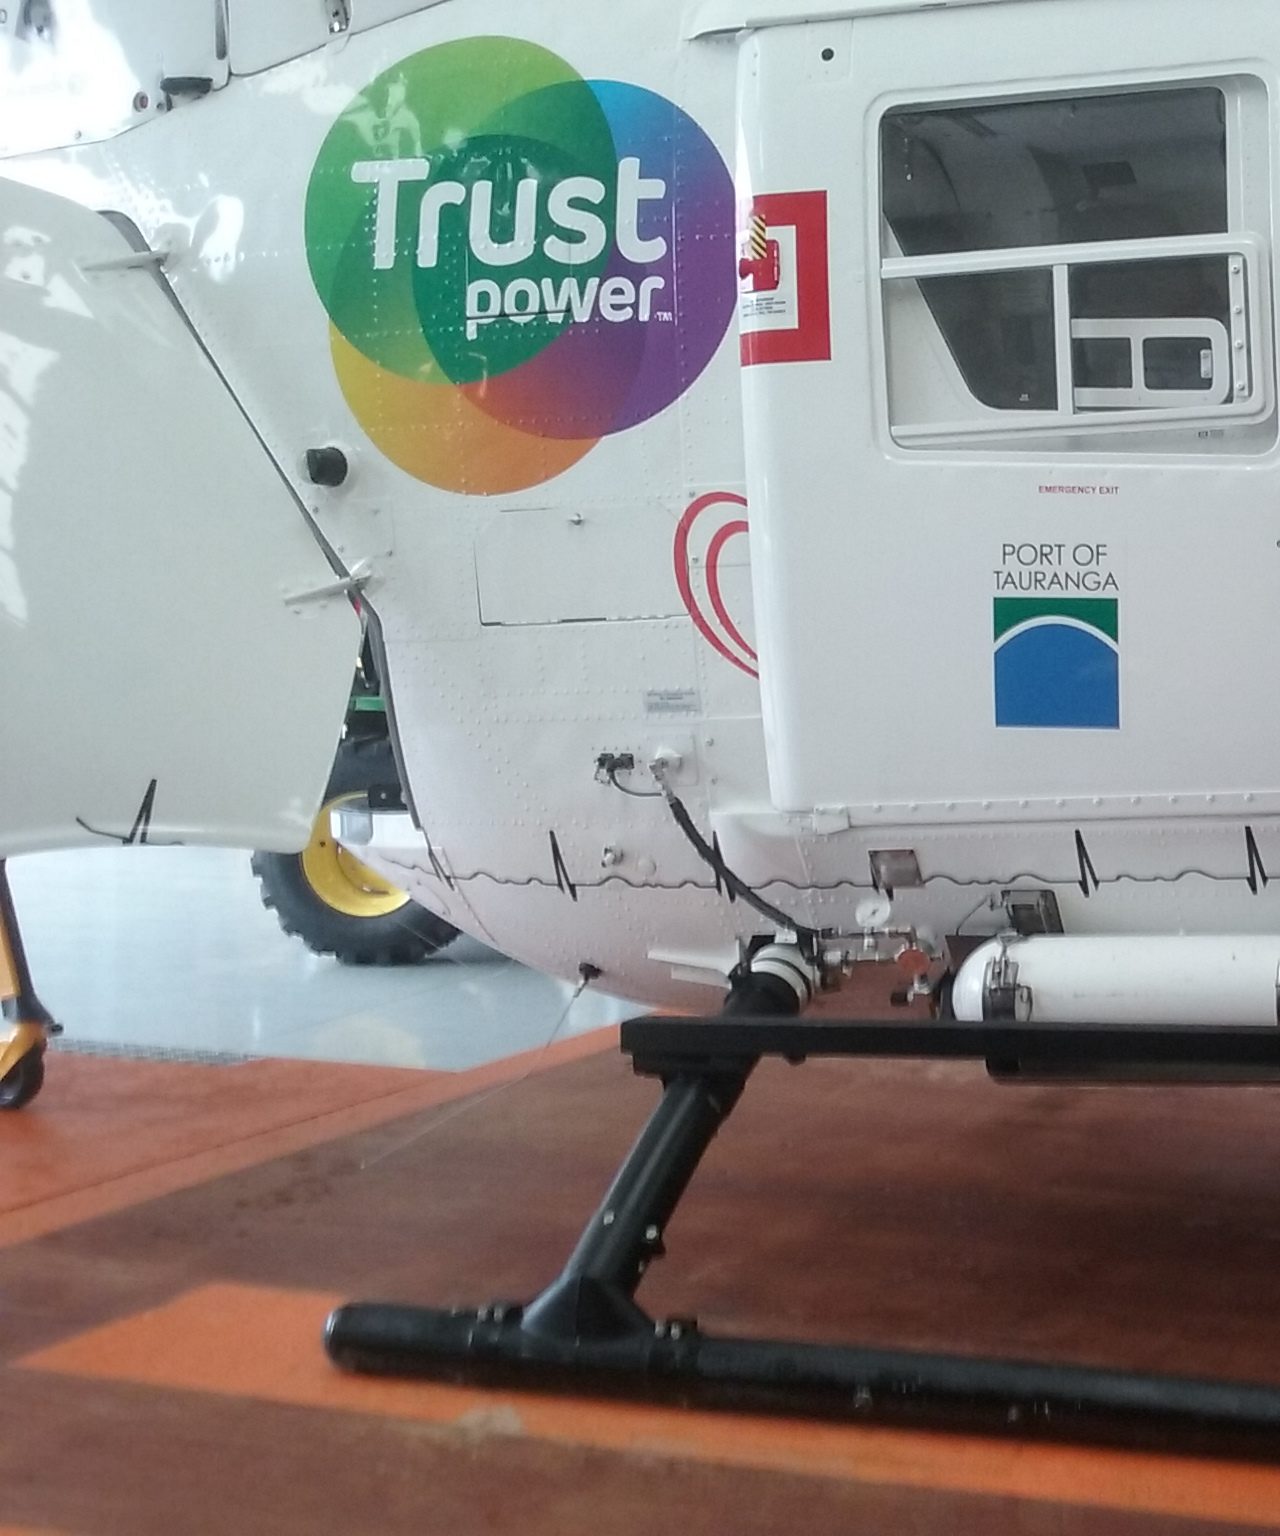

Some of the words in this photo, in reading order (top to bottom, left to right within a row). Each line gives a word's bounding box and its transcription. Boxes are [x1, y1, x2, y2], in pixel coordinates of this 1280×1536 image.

[351, 157, 667, 269] Trust
[466, 276, 665, 341] power
[1038, 485, 1097, 495] EMERGENCY
[1099, 485, 1119, 495] EXIT
[1002, 543, 1066, 566] PORT
[1072, 543, 1108, 566] OF
[993, 570, 1119, 592] TAURANGA
